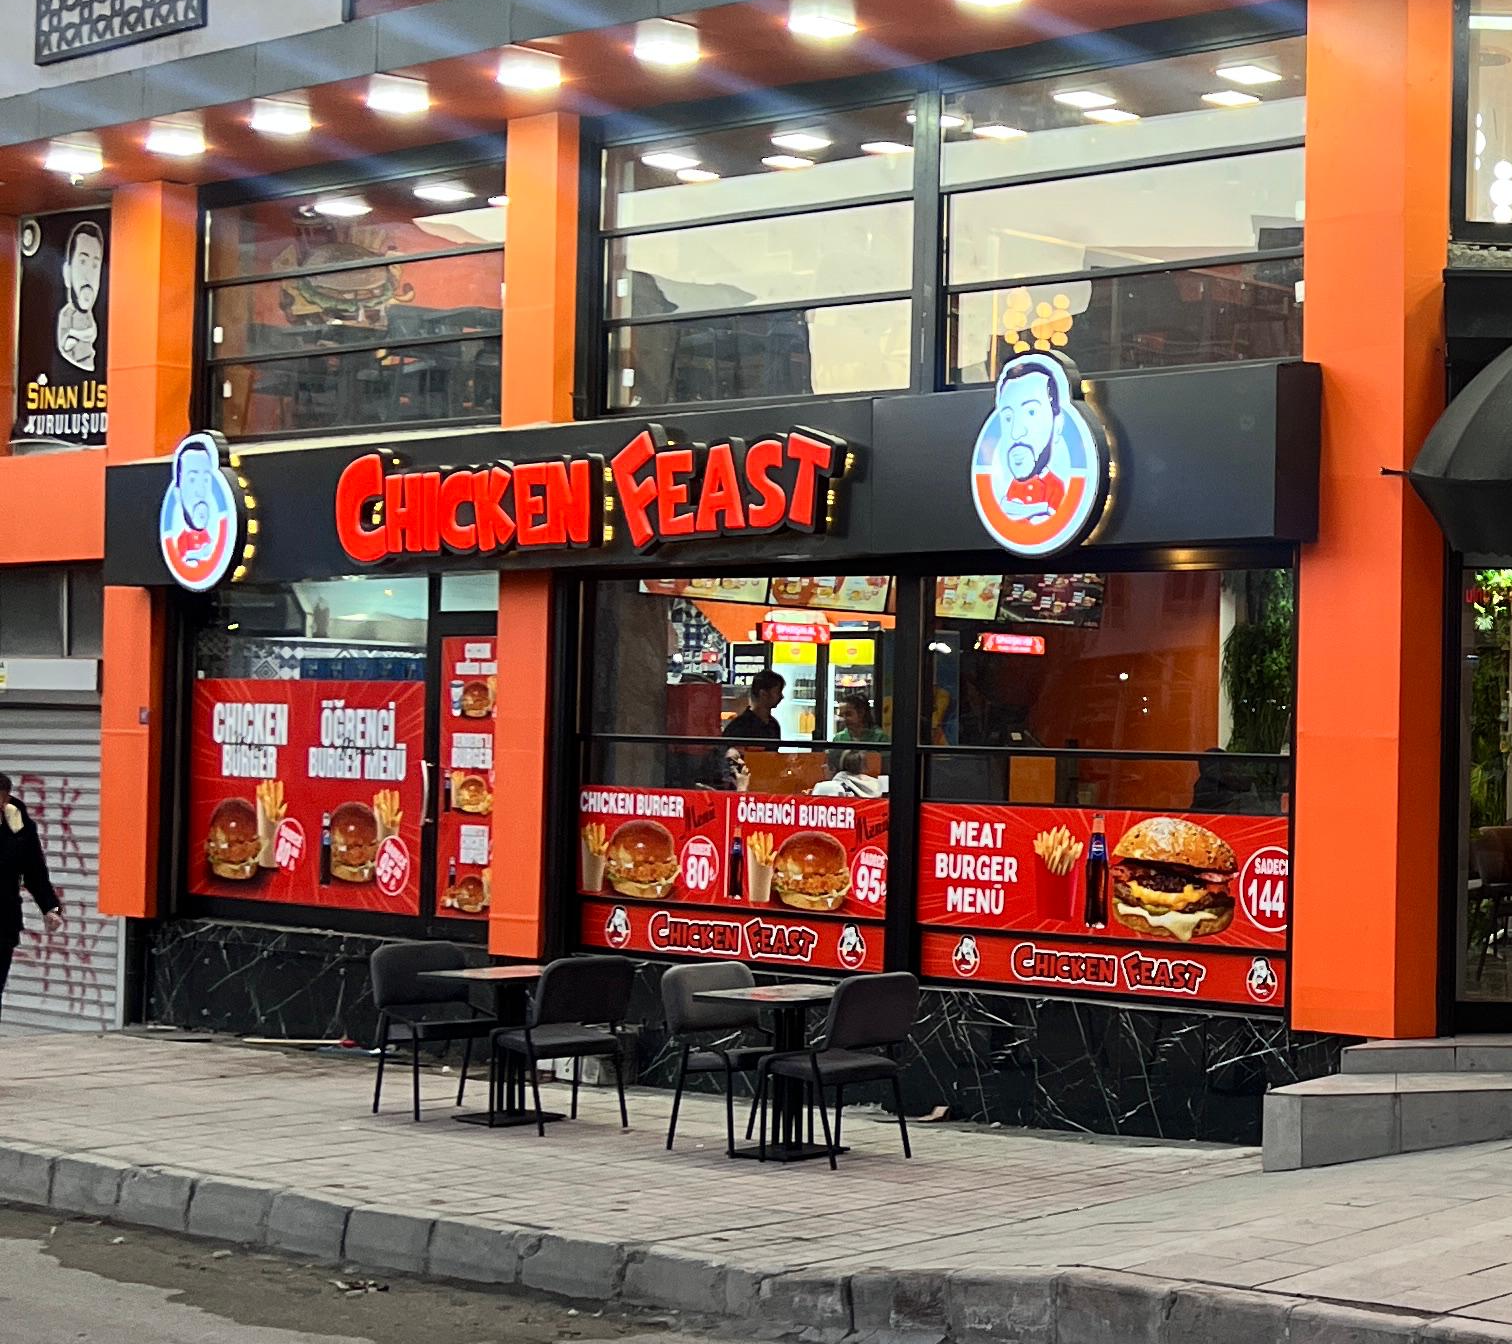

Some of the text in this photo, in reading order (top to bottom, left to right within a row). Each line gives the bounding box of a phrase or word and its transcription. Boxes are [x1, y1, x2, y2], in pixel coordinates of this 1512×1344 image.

[334, 428, 833, 563] CHICKEN FEAST
[579, 791, 685, 819] CHICKEN BURGER
[737, 796, 856, 830] ÖĞRENCİ BURGER
[949, 820, 1006, 849] MEAT
[934, 852, 1018, 883] BURGER
[946, 883, 1005, 915] MENÜ
[1247, 878, 1286, 919] 144
[648, 910, 818, 961] CHICKEN FEAST
[1011, 942, 1207, 995] CHICKEN FEAST
